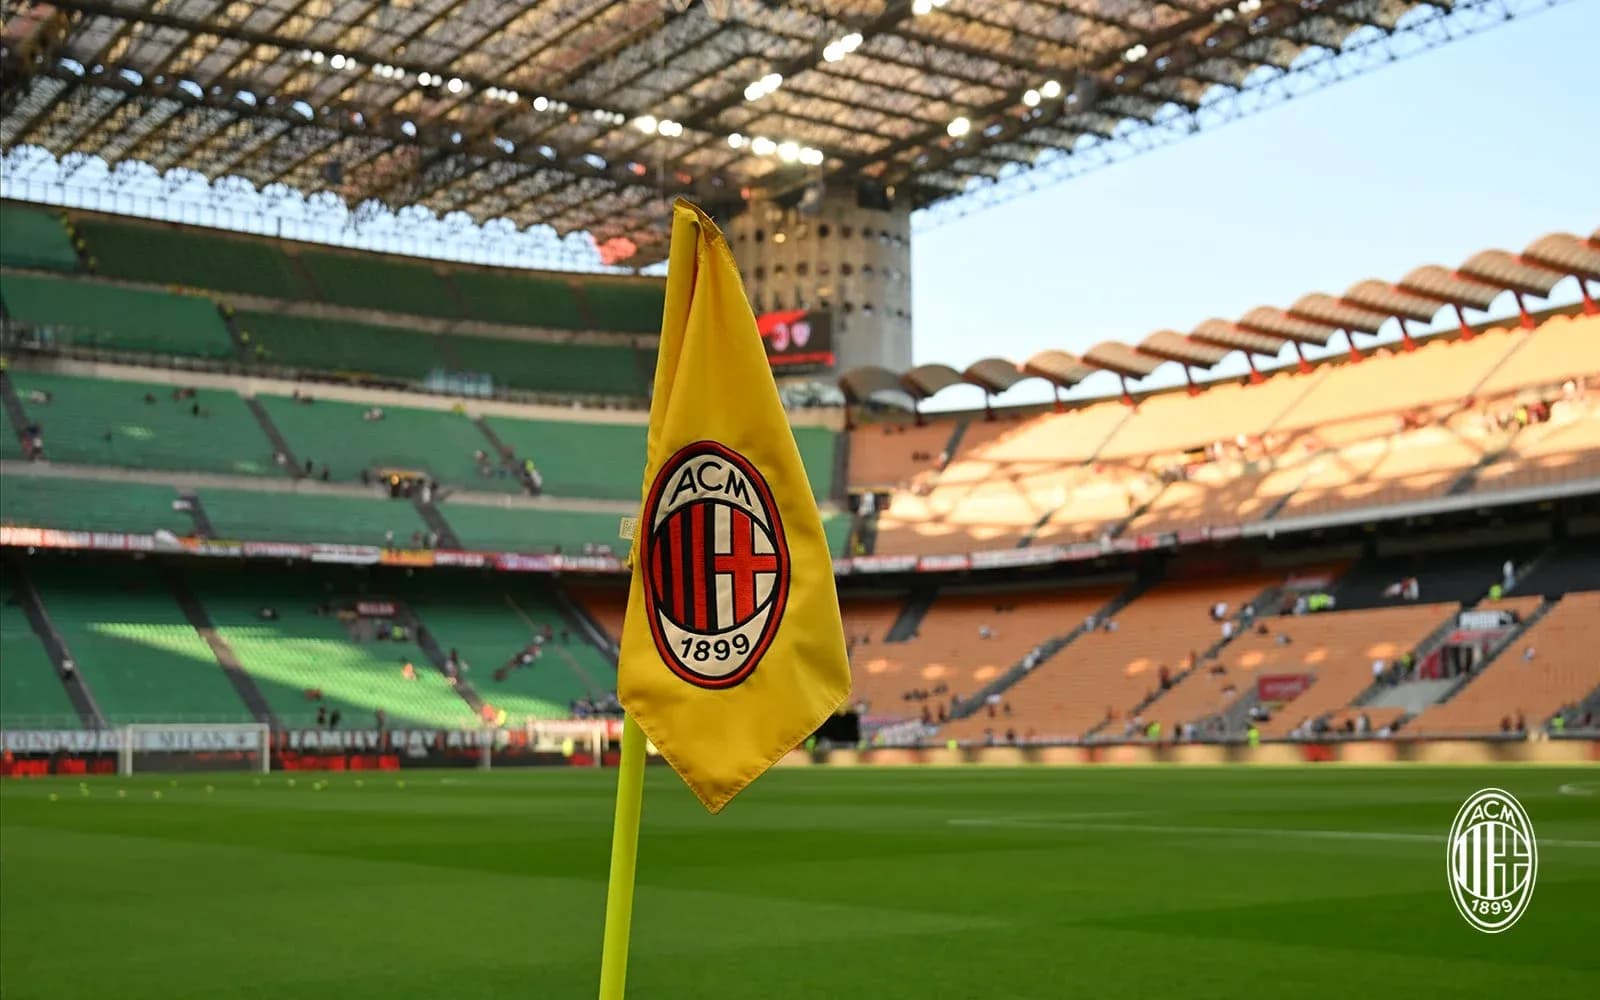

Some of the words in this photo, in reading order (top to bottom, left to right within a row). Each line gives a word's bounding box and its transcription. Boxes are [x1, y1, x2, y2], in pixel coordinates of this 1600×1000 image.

[668, 461, 752, 507] ACM
[680, 633, 750, 662] 1899
[160, 731, 226, 747] MILAN
[290, 730, 379, 748] FAMILY
